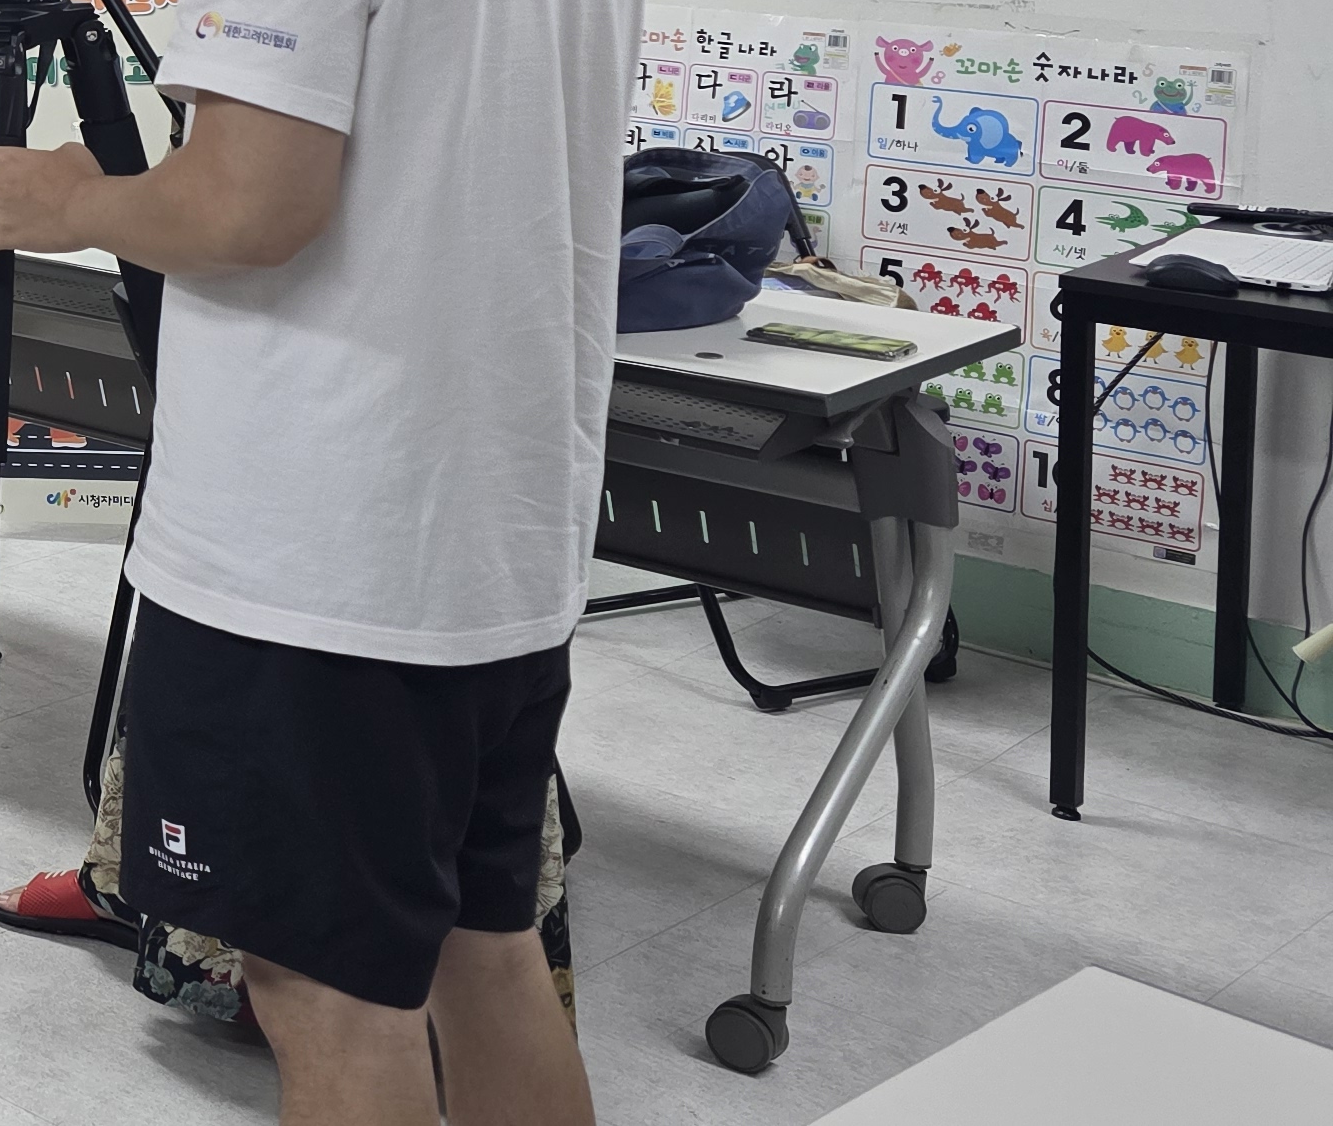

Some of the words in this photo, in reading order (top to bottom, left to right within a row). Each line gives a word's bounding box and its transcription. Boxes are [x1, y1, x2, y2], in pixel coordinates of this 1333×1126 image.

[222, 23, 298, 52] 대한고려인협회
[640, 28, 687, 52] 마손
[696, 28, 778, 60] 한글나라
[954, 57, 1024, 84] 꼬마손
[1032, 51, 1139, 86] 숫자나라
[696, 69, 723, 100] 다
[768, 77, 799, 108] 라
[890, 92, 909, 131] 1
[877, 136, 919, 153] 일/하나
[1059, 111, 1092, 152] 2
[879, 175, 909, 214] 3
[1055, 198, 1087, 237] 4
[1052, 243, 1087, 261] 사/넷
[176, 859, 211, 873] ITALIA
